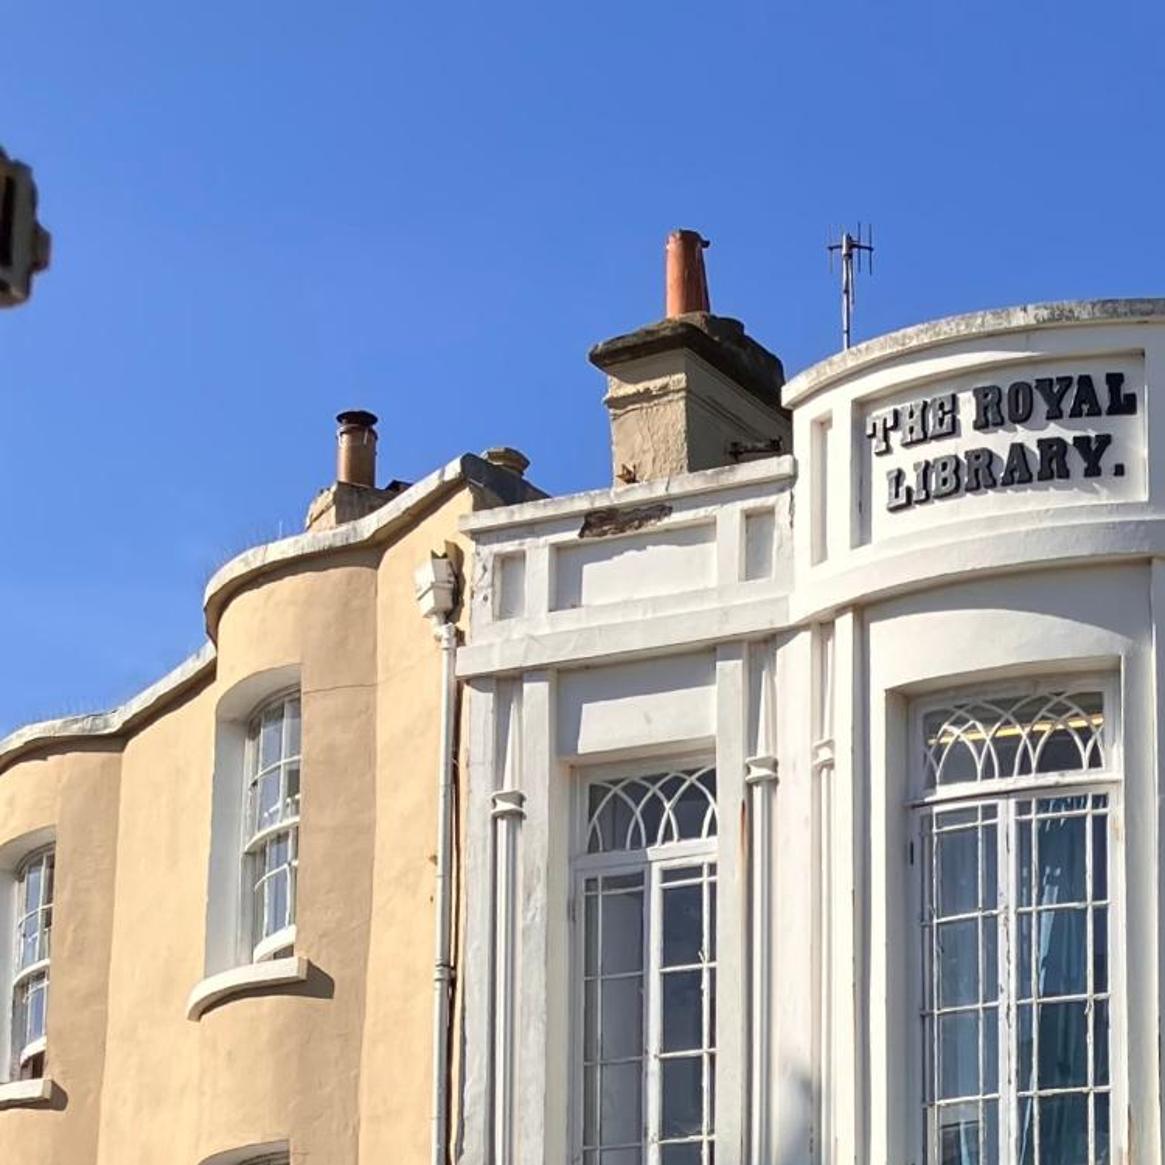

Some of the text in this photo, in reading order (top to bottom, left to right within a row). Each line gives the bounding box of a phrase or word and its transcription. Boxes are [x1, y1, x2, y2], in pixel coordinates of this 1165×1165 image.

[866, 372, 1138, 456] THE ROYAL
[886, 434, 1126, 513] LIBRARY.
